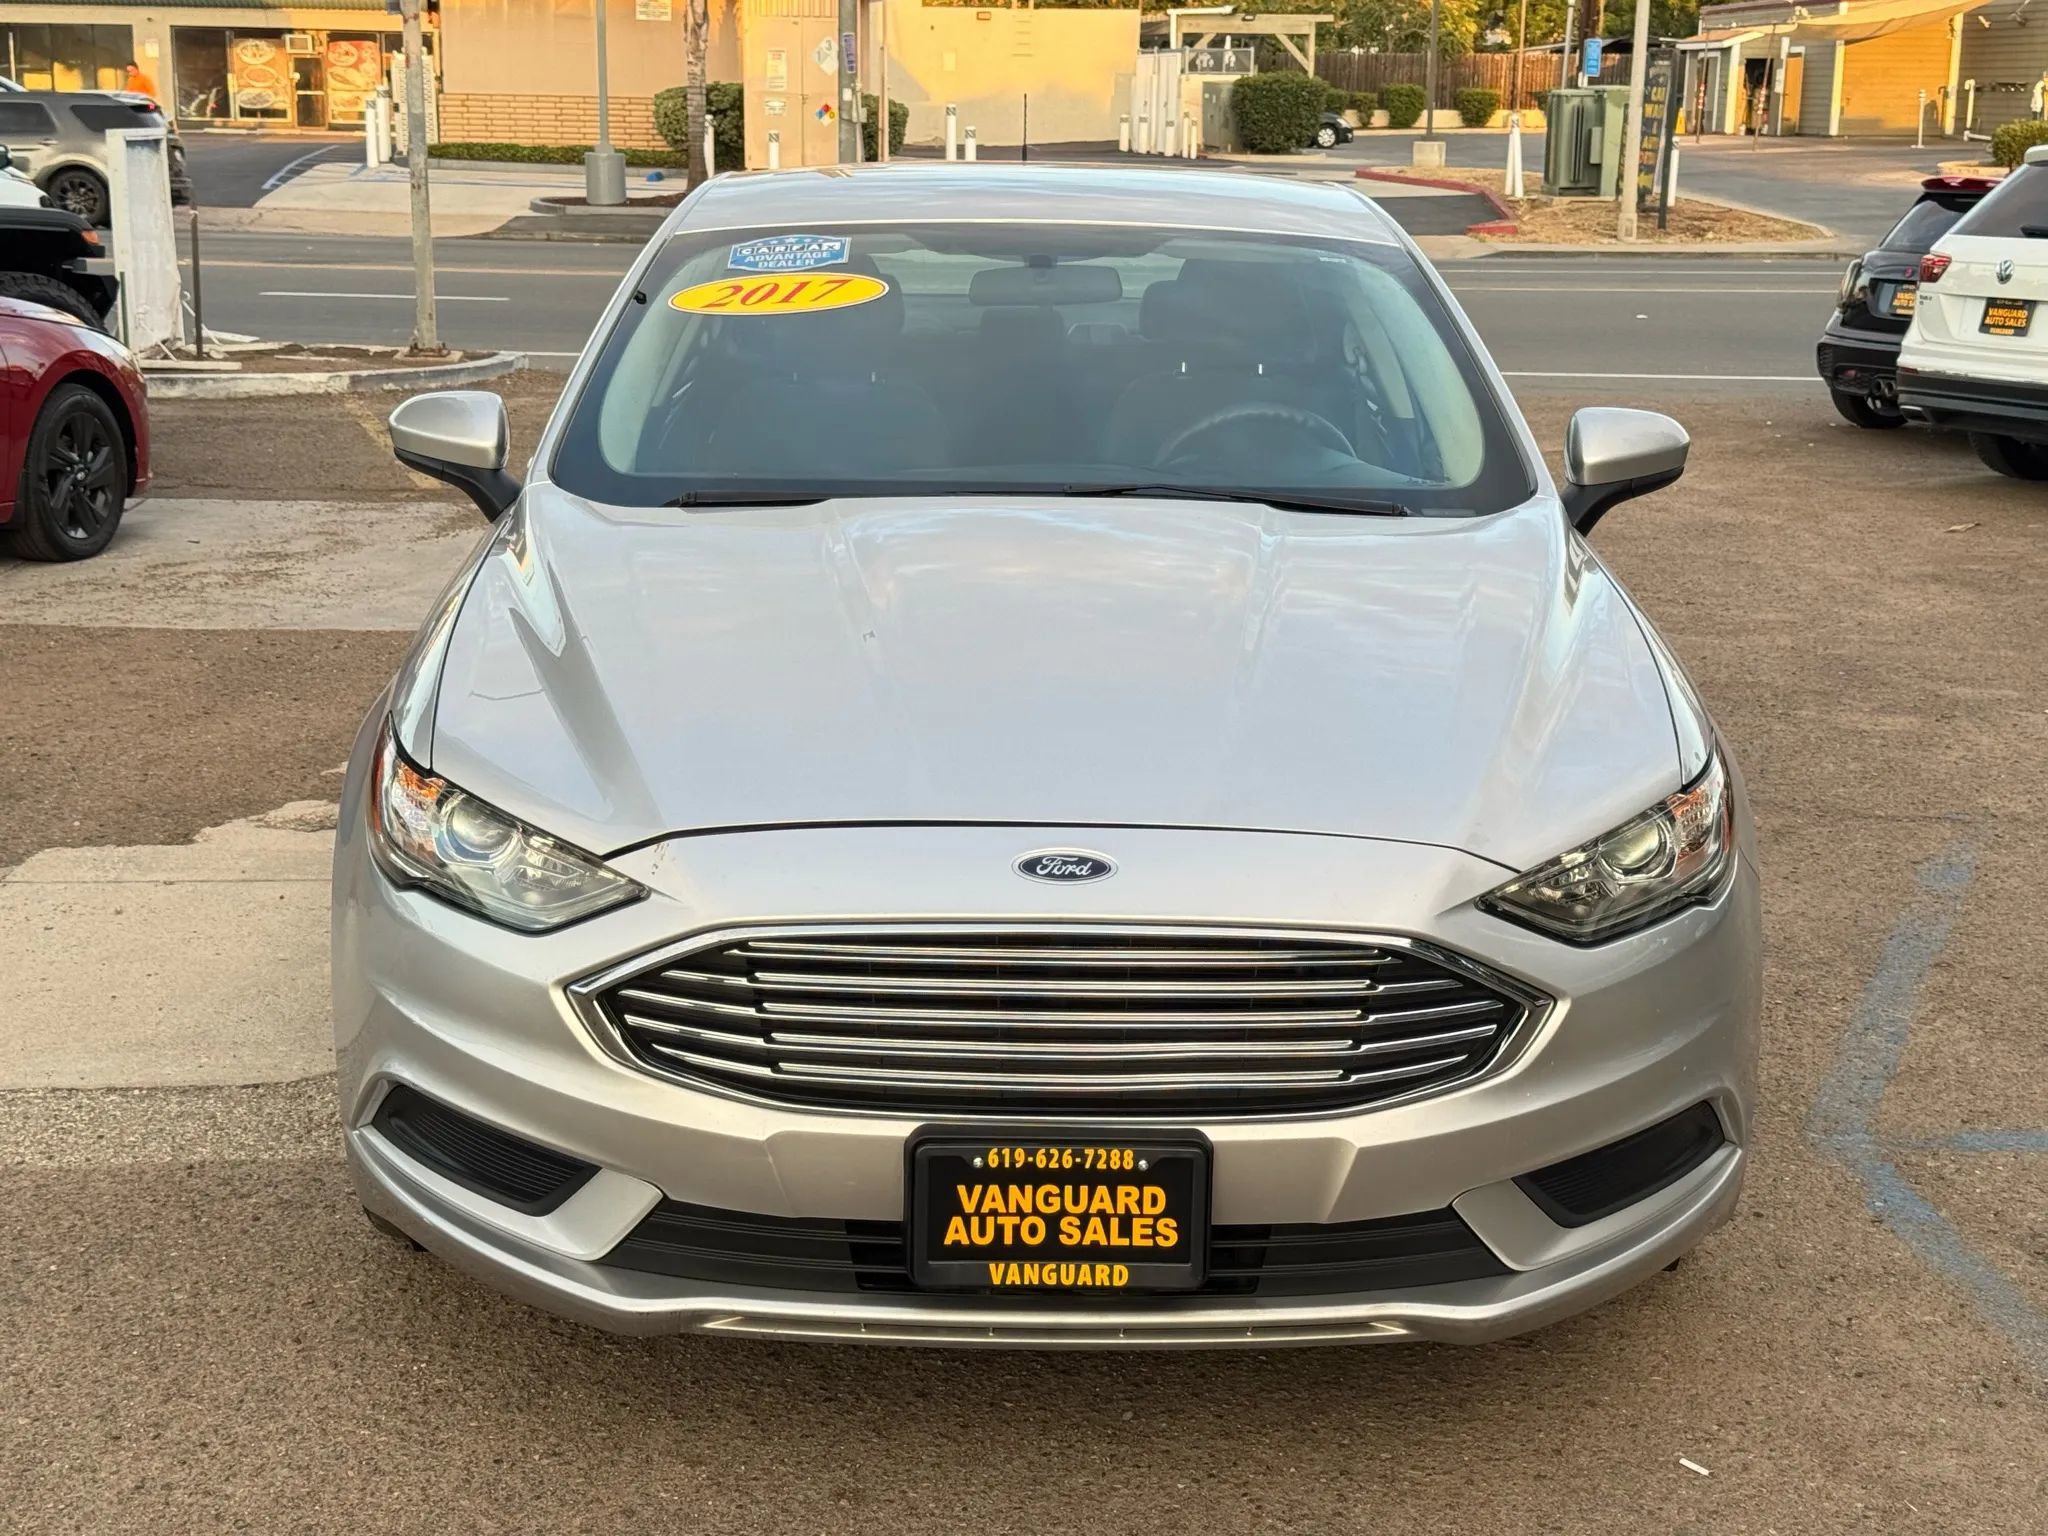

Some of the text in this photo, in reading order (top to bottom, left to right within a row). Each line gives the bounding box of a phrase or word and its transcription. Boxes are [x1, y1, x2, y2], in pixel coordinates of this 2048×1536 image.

[739, 243, 840, 256] CARFAX
[745, 252, 831, 263] ADVANTAGE
[758, 259, 815, 269] DEALER
[701, 279, 853, 309] 2017
[1984, 316, 2027, 327] AUTO SALES
[1988, 307, 2028, 318] VANGUARD
[1036, 856, 1092, 875] Ford
[987, 1147, 1135, 1170] 619-626-7288
[956, 1184, 1167, 1215] VANGUARD
[943, 1215, 1179, 1248] AUTO SALES
[988, 1262, 1129, 1288] VANGUARD
